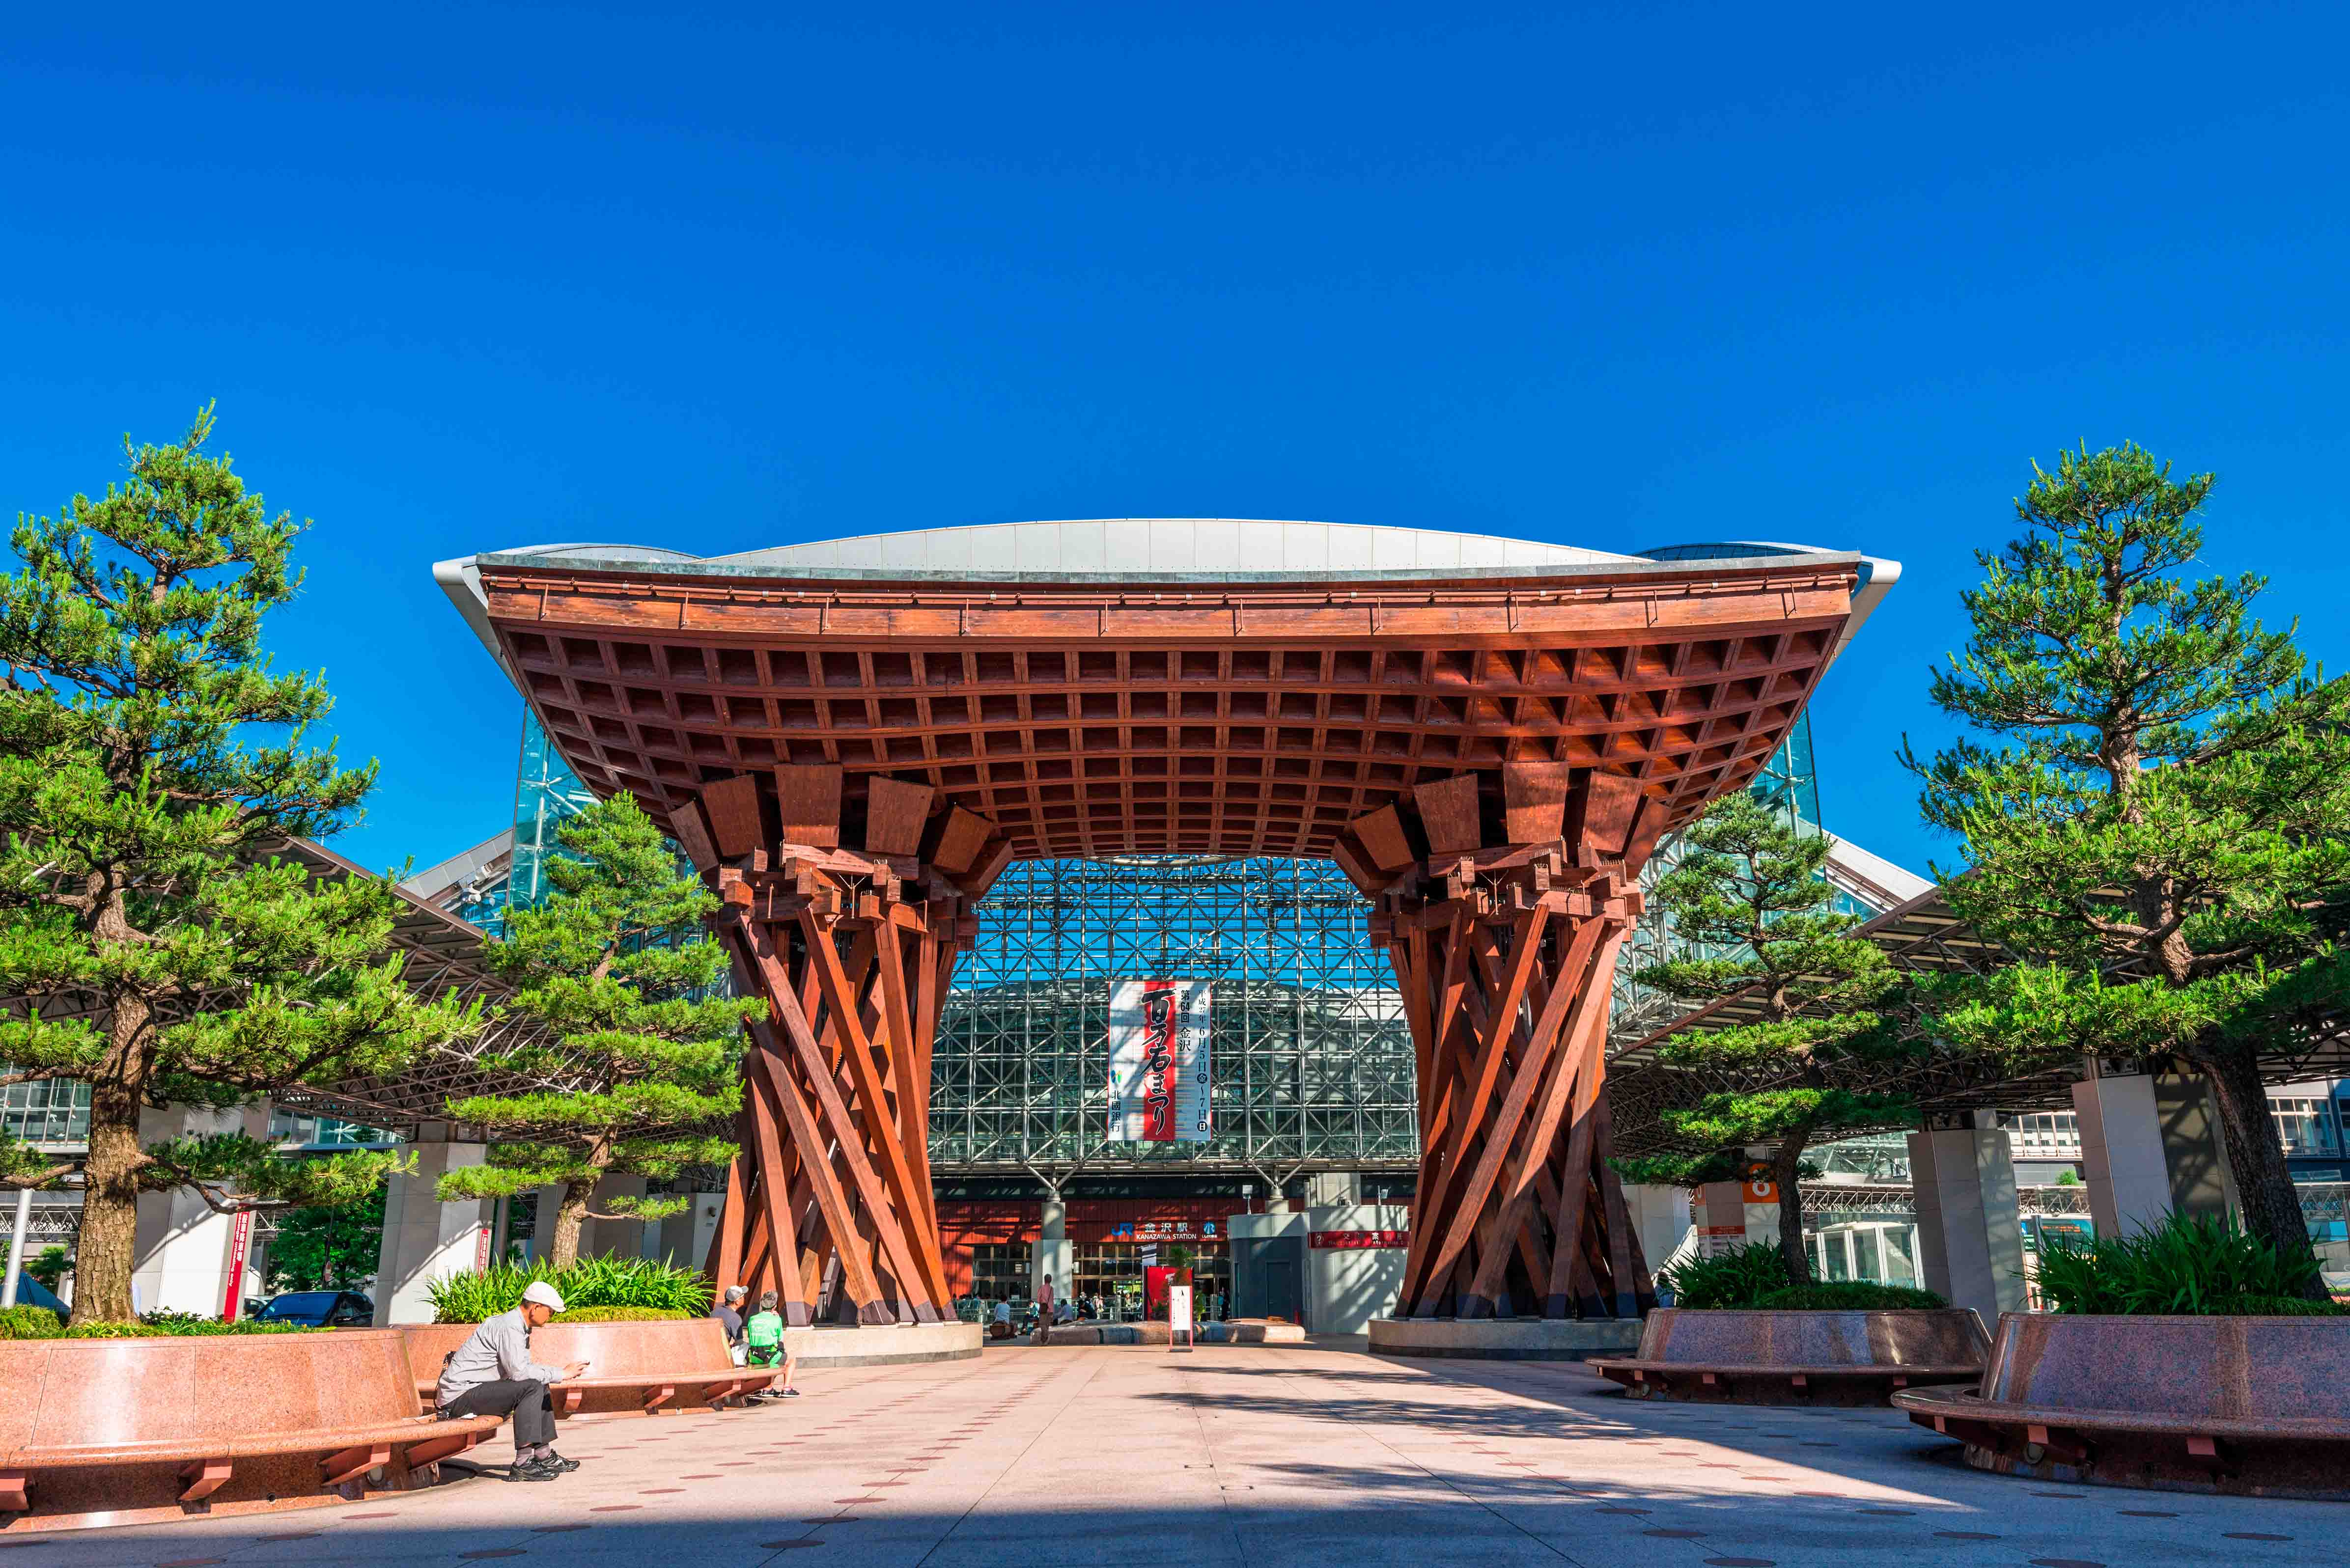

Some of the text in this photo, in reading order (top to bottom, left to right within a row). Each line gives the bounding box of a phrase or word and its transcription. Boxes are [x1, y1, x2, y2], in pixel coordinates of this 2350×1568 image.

[1140, 988, 1177, 1135] 百万石まつり
[1111, 1090, 1120, 1131] 北國銀行
[1112, 1222, 1133, 1236] JR
[1145, 1222, 1187, 1233] 金沢駅
